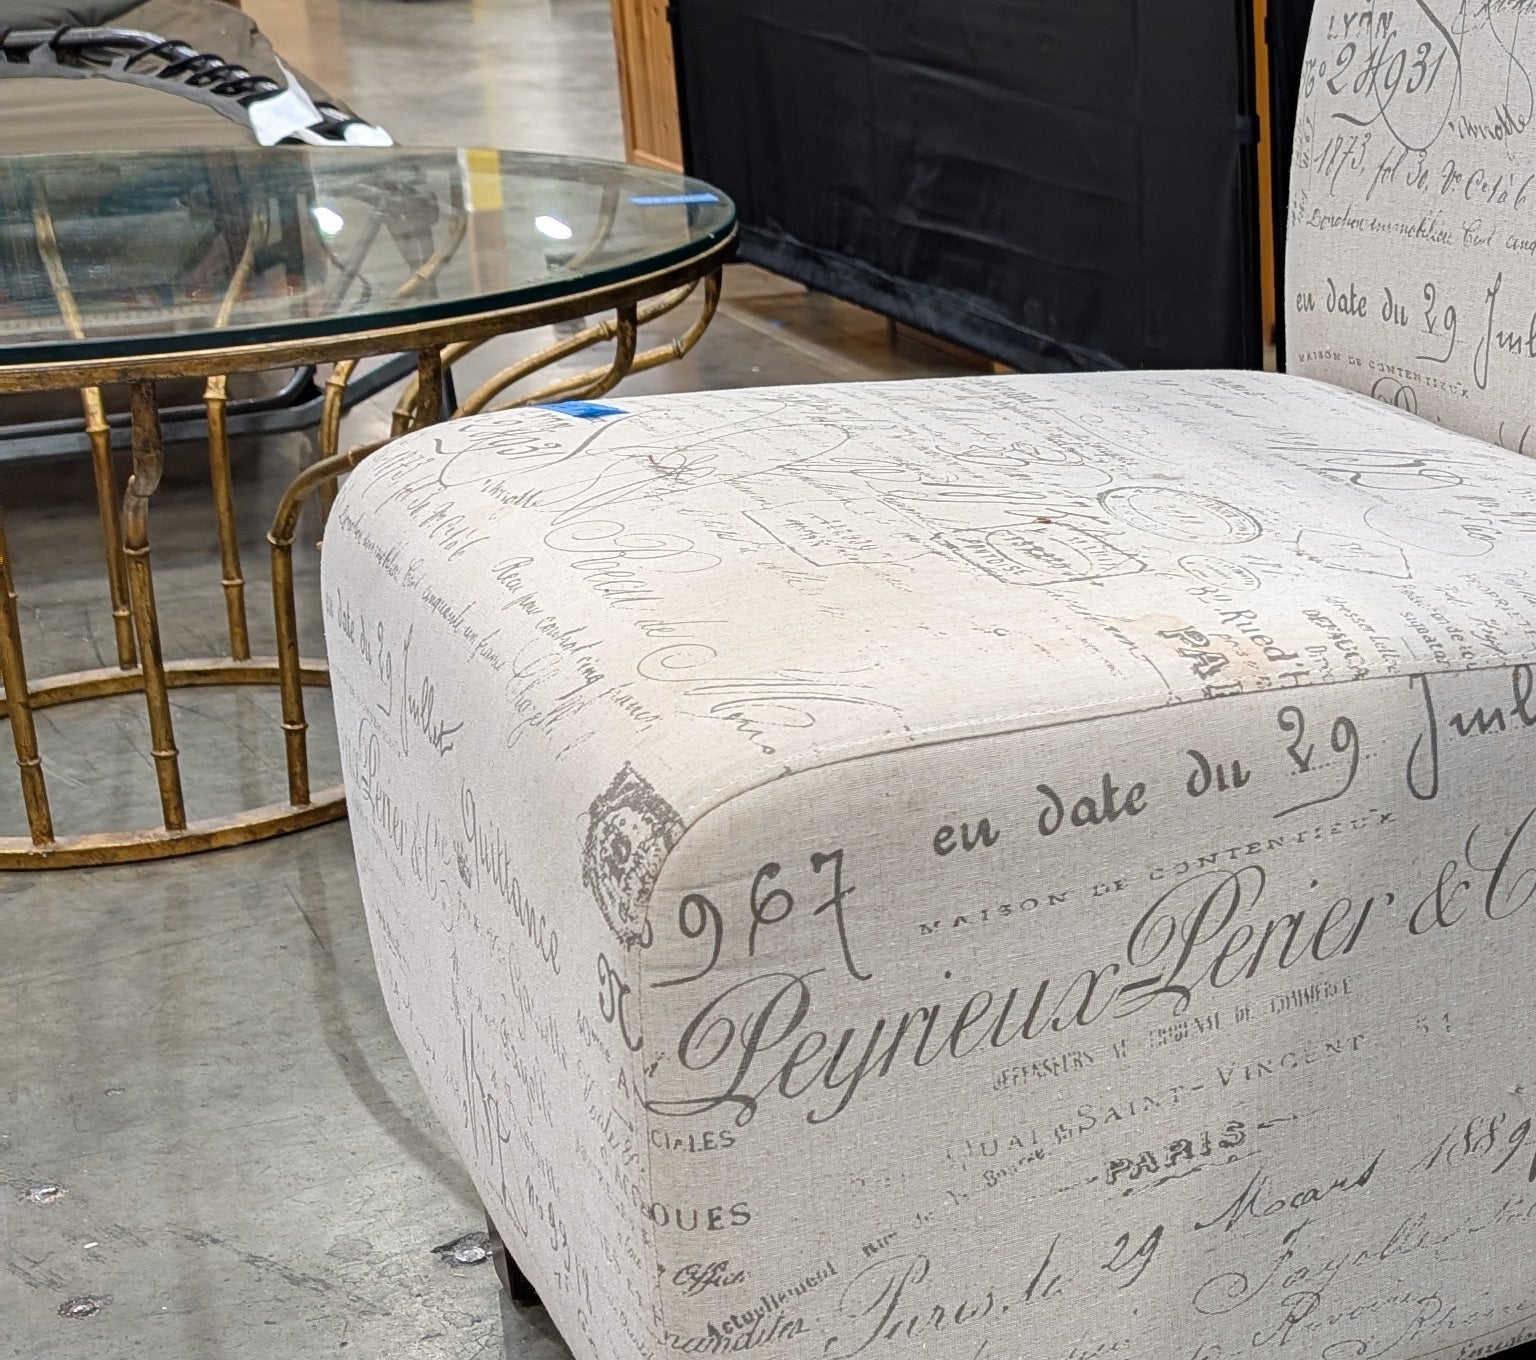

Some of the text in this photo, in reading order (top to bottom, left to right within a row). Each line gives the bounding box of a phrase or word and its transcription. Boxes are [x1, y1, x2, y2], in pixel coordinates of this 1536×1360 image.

[1326, 277, 1368, 319] date
[1382, 286, 1409, 327] du
[1415, 281, 1458, 365] 29
[1036, 773, 1148, 837] date
[1185, 749, 1252, 798] du
[1273, 704, 1361, 818] 29
[651, 846, 873, 989] 967
[1104, 1119, 1247, 1185] PARIS
